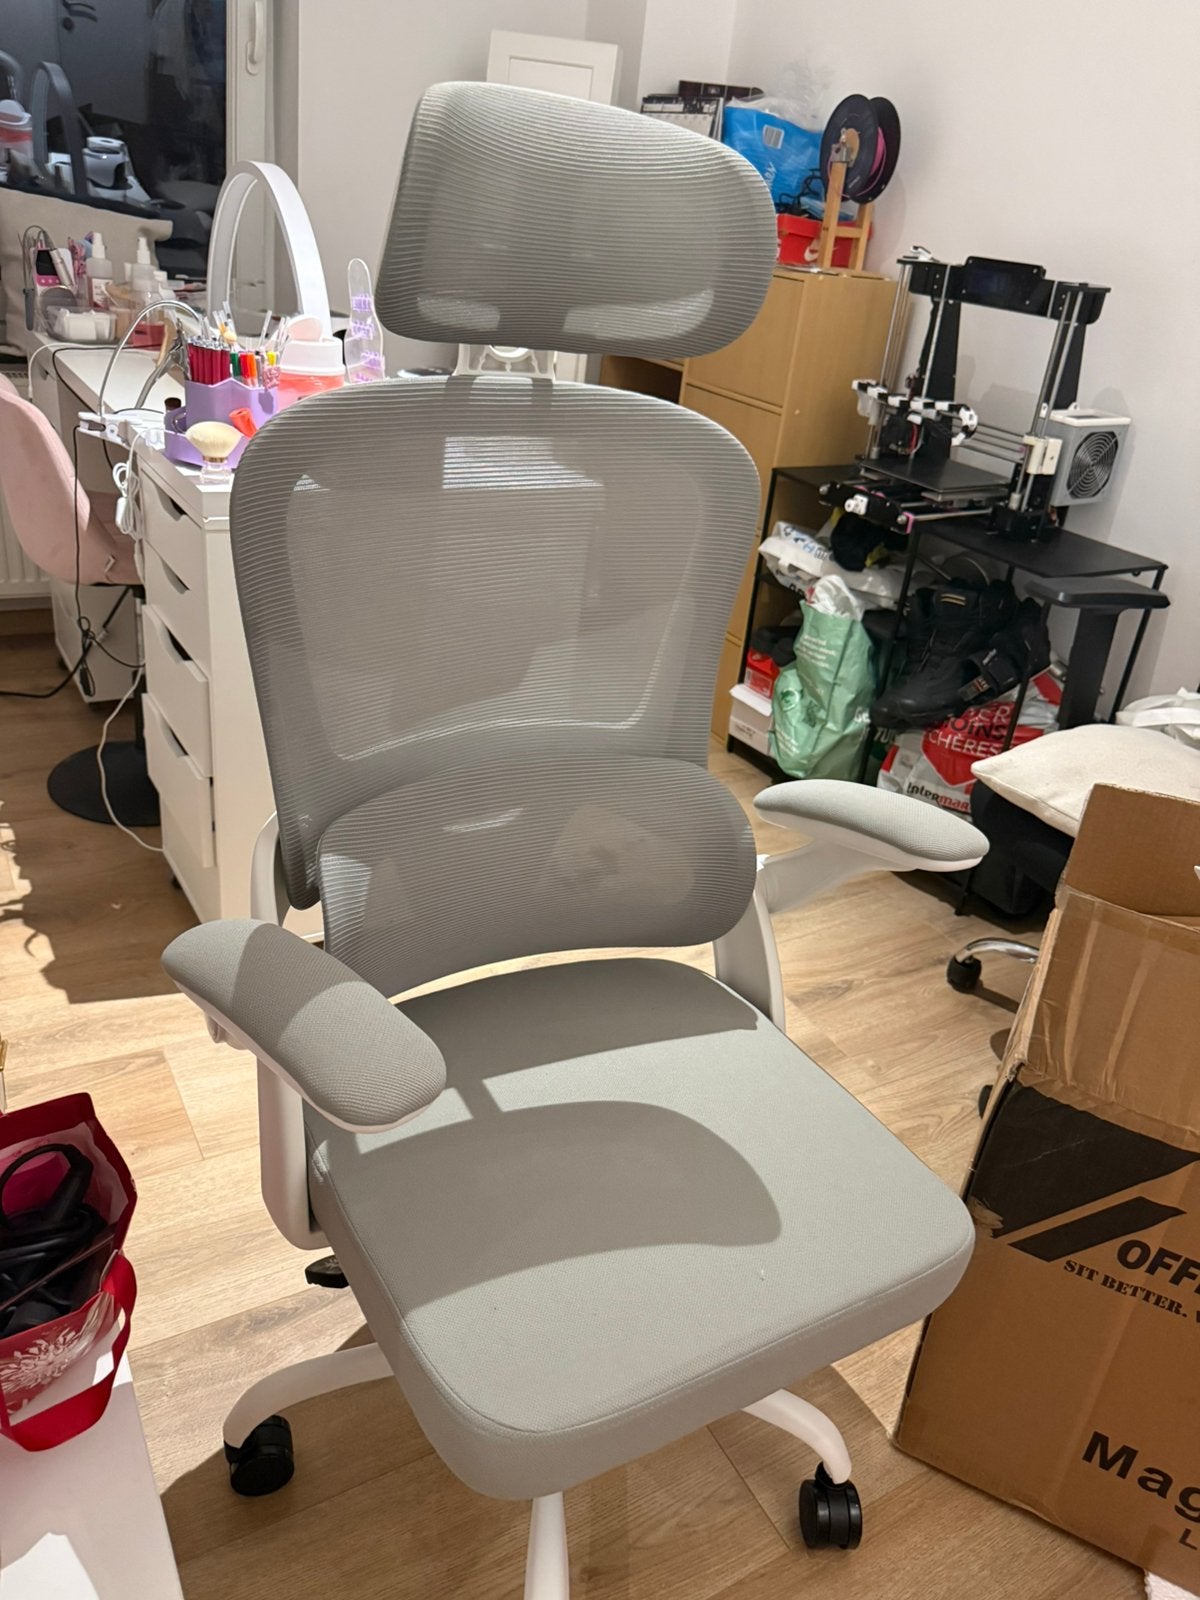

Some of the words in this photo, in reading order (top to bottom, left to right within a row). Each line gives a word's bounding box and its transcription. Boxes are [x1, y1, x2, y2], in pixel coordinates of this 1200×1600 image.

[946, 714, 1007, 741] OINS
[1063, 1259, 1099, 1282] SIT
[1100, 1274, 1188, 1318] BETTER.
